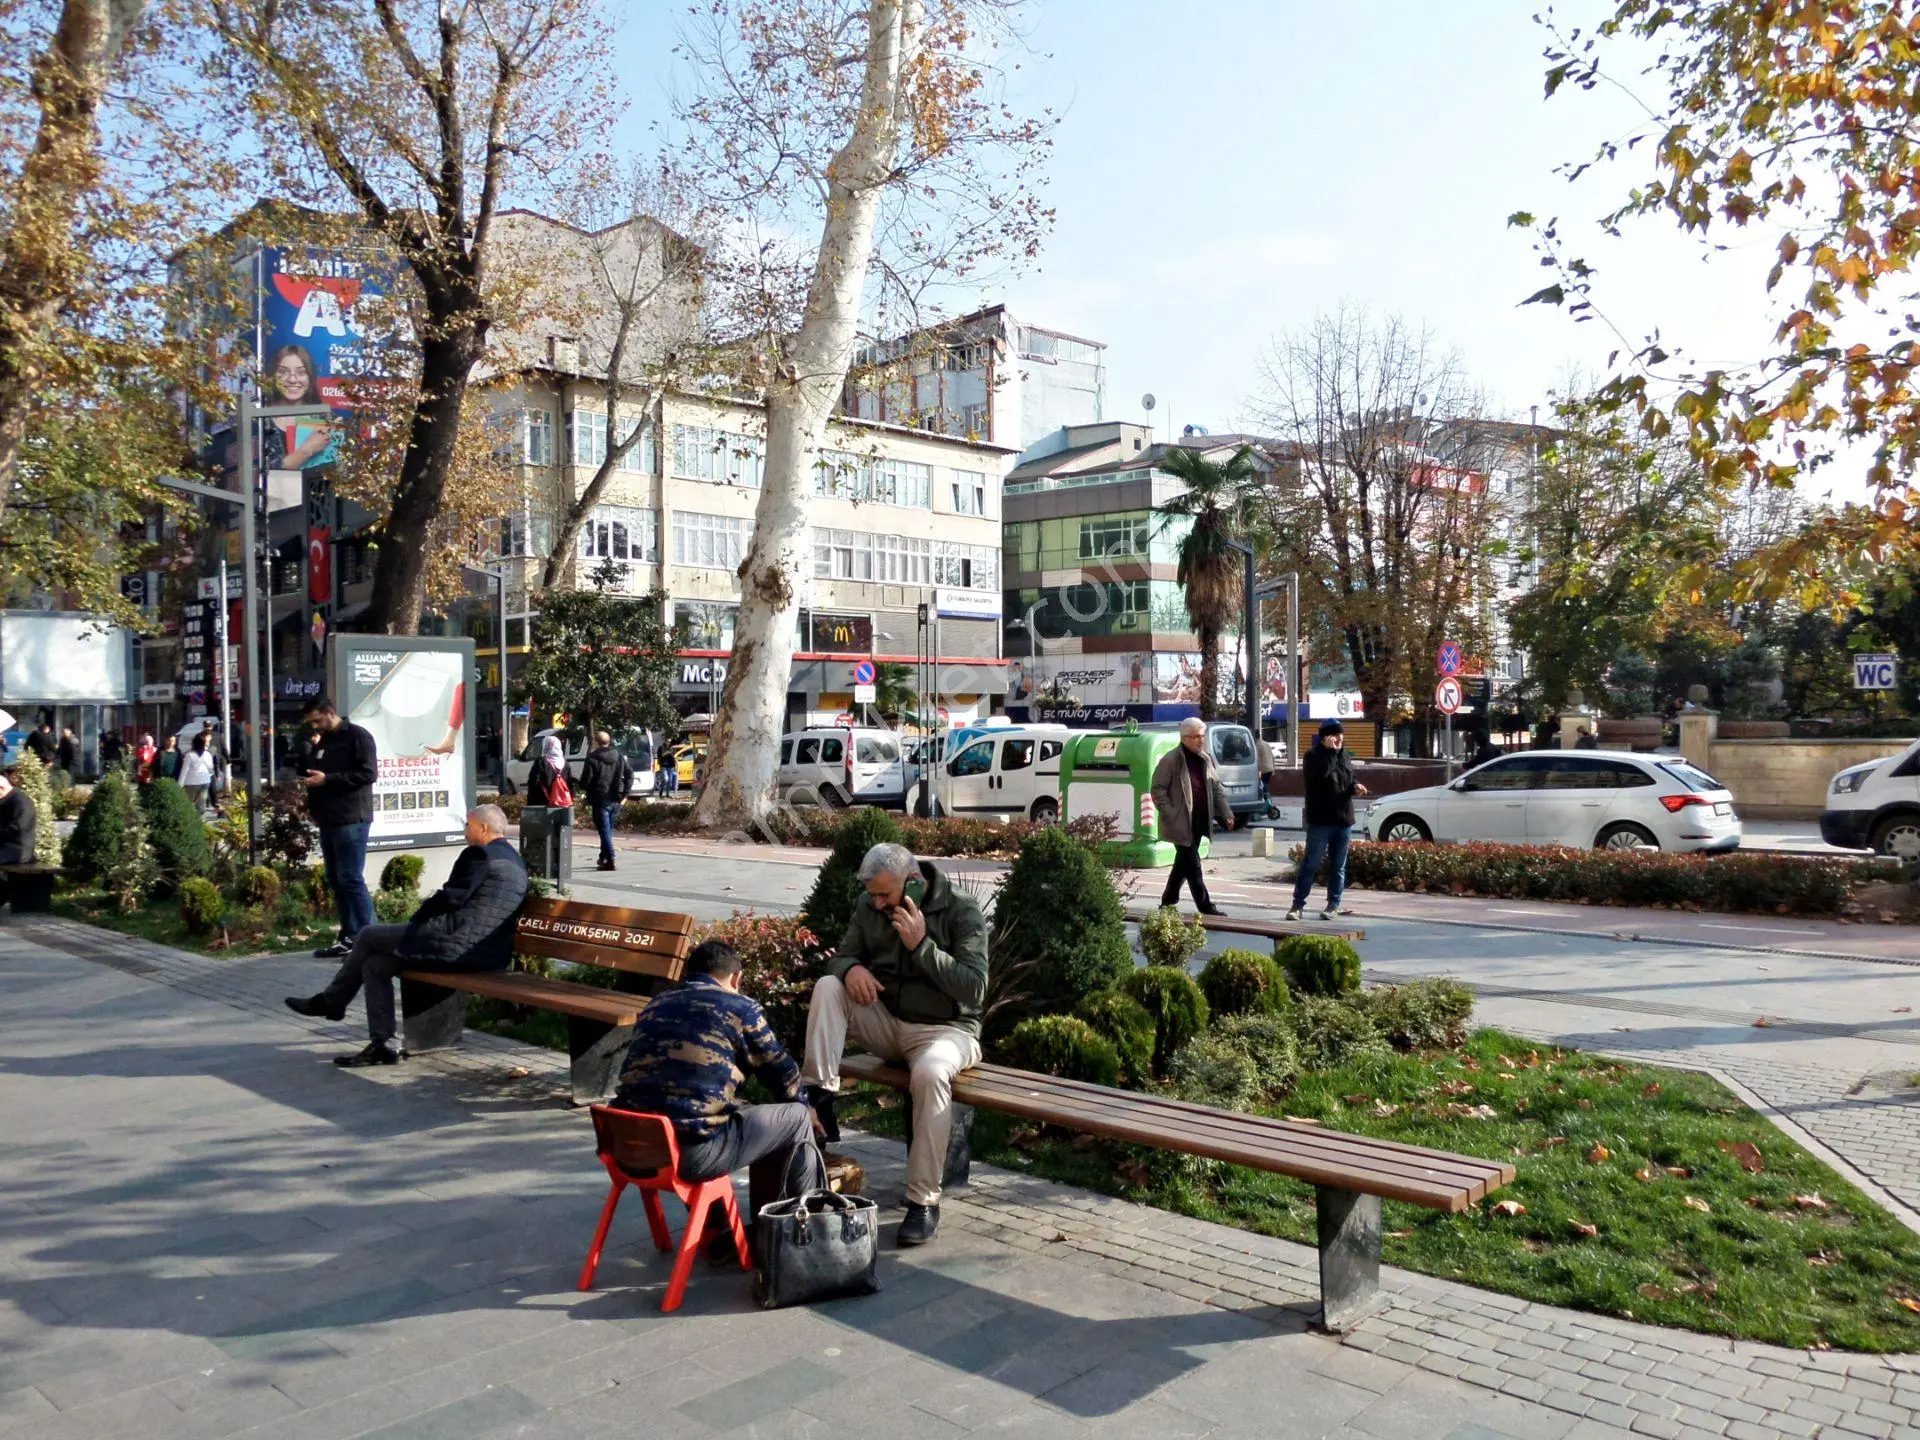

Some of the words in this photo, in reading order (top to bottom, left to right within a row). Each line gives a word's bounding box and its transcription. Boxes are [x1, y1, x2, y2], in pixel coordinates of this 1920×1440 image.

[355, 653, 398, 663] ALLIANCE
[683, 664, 727, 683] McD
[1056, 669, 1117, 678] SKECHERS
[1857, 664, 1892, 686] WC
[1094, 705, 1127, 721] sport
[518, 917, 550, 931] CAELİ
[553, 922, 620, 941] BÜYÜKŞEHİR
[625, 933, 655, 946] 2021
